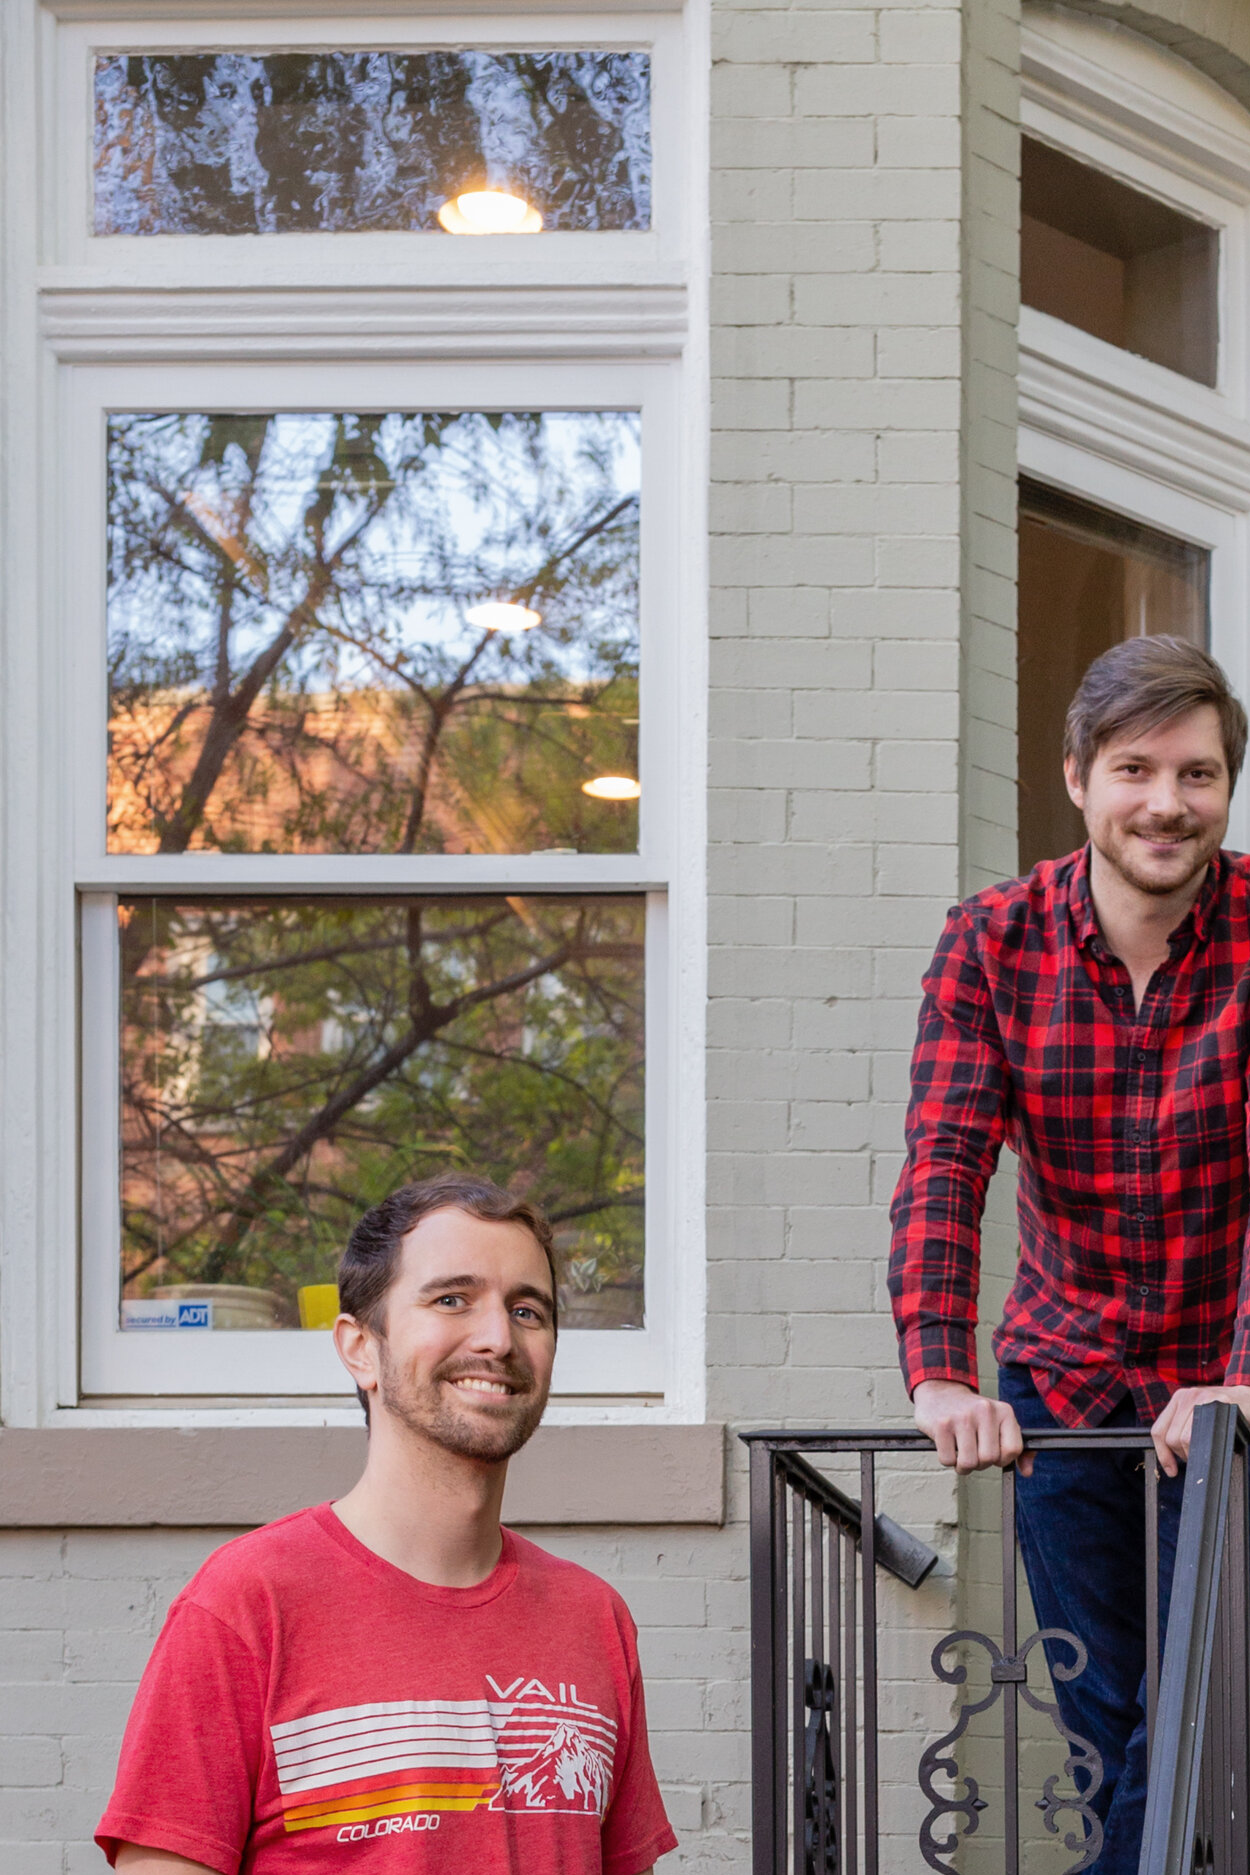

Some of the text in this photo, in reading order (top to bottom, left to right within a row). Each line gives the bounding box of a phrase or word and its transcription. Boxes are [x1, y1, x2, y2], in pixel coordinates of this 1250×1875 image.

[180, 1307, 208, 1325] ADT
[485, 1674, 598, 1711] VAIL
[336, 1813, 441, 1843] COLORADO
